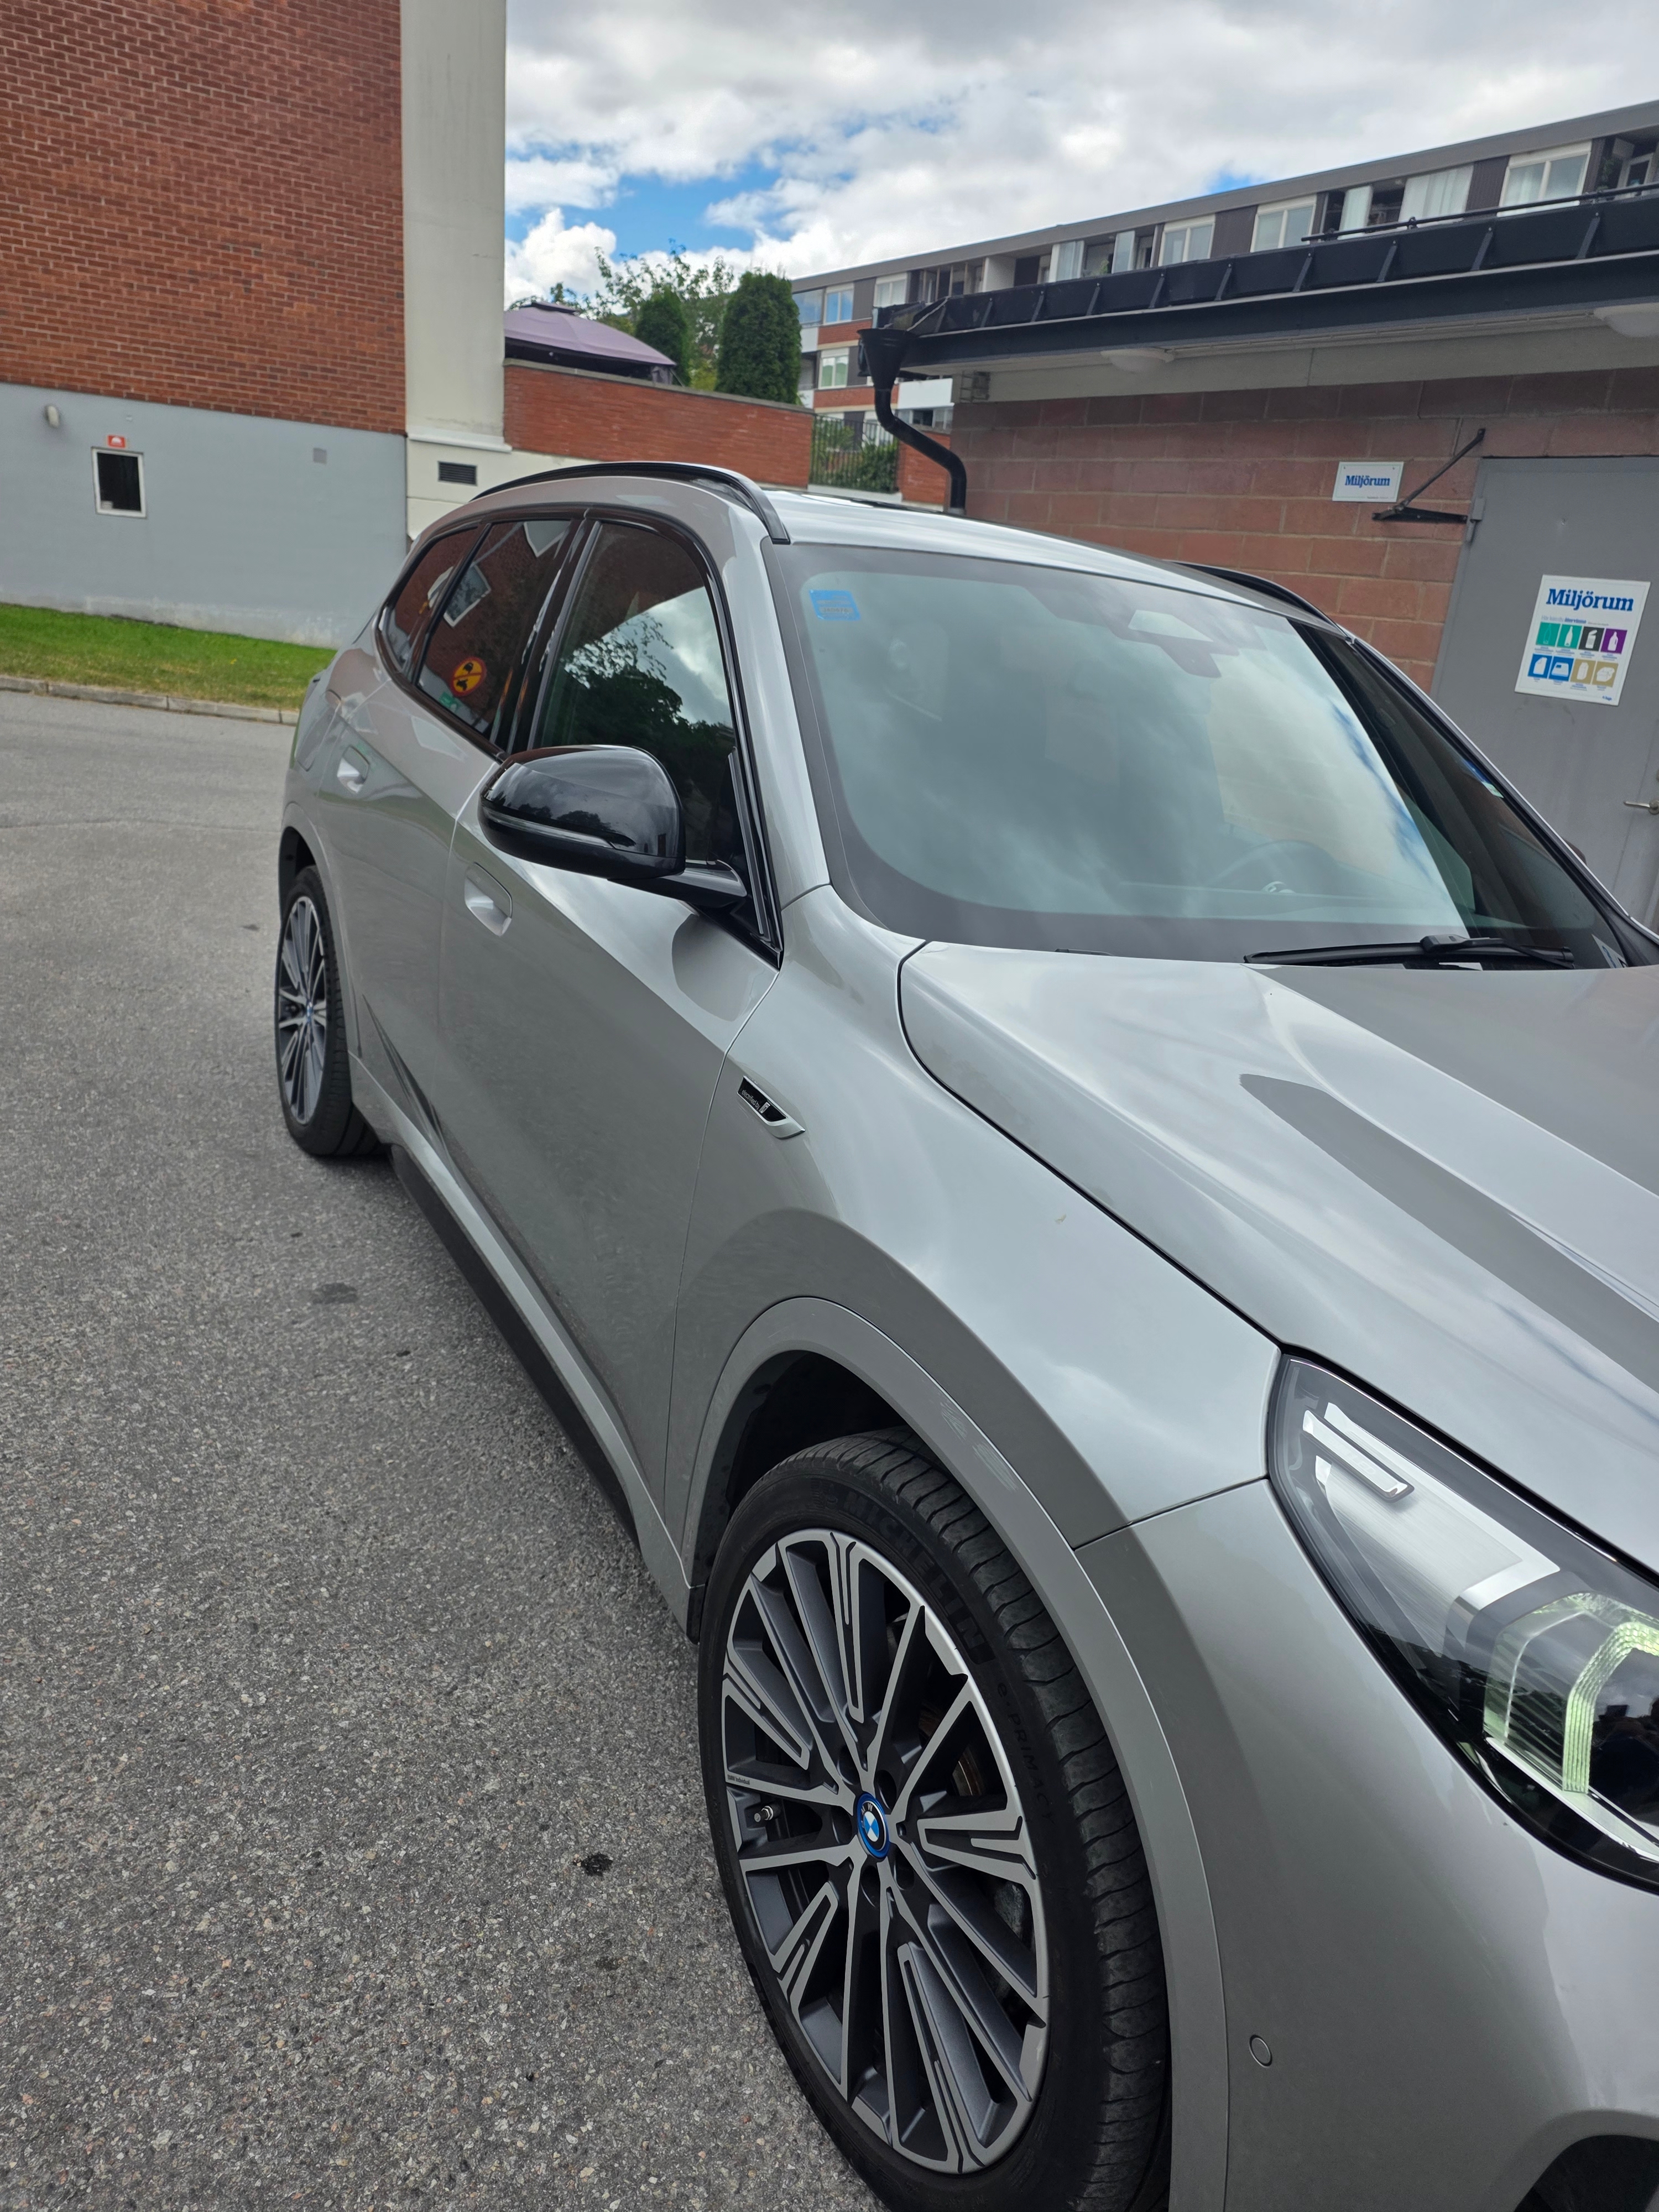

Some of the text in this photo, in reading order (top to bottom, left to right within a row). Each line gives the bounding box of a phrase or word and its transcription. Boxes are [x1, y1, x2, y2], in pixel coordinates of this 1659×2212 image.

[1345, 475, 1390, 488] Miljörum
[1546, 588, 1634, 612] Miljörum
[843, 1491, 985, 1652] MICHELIN
